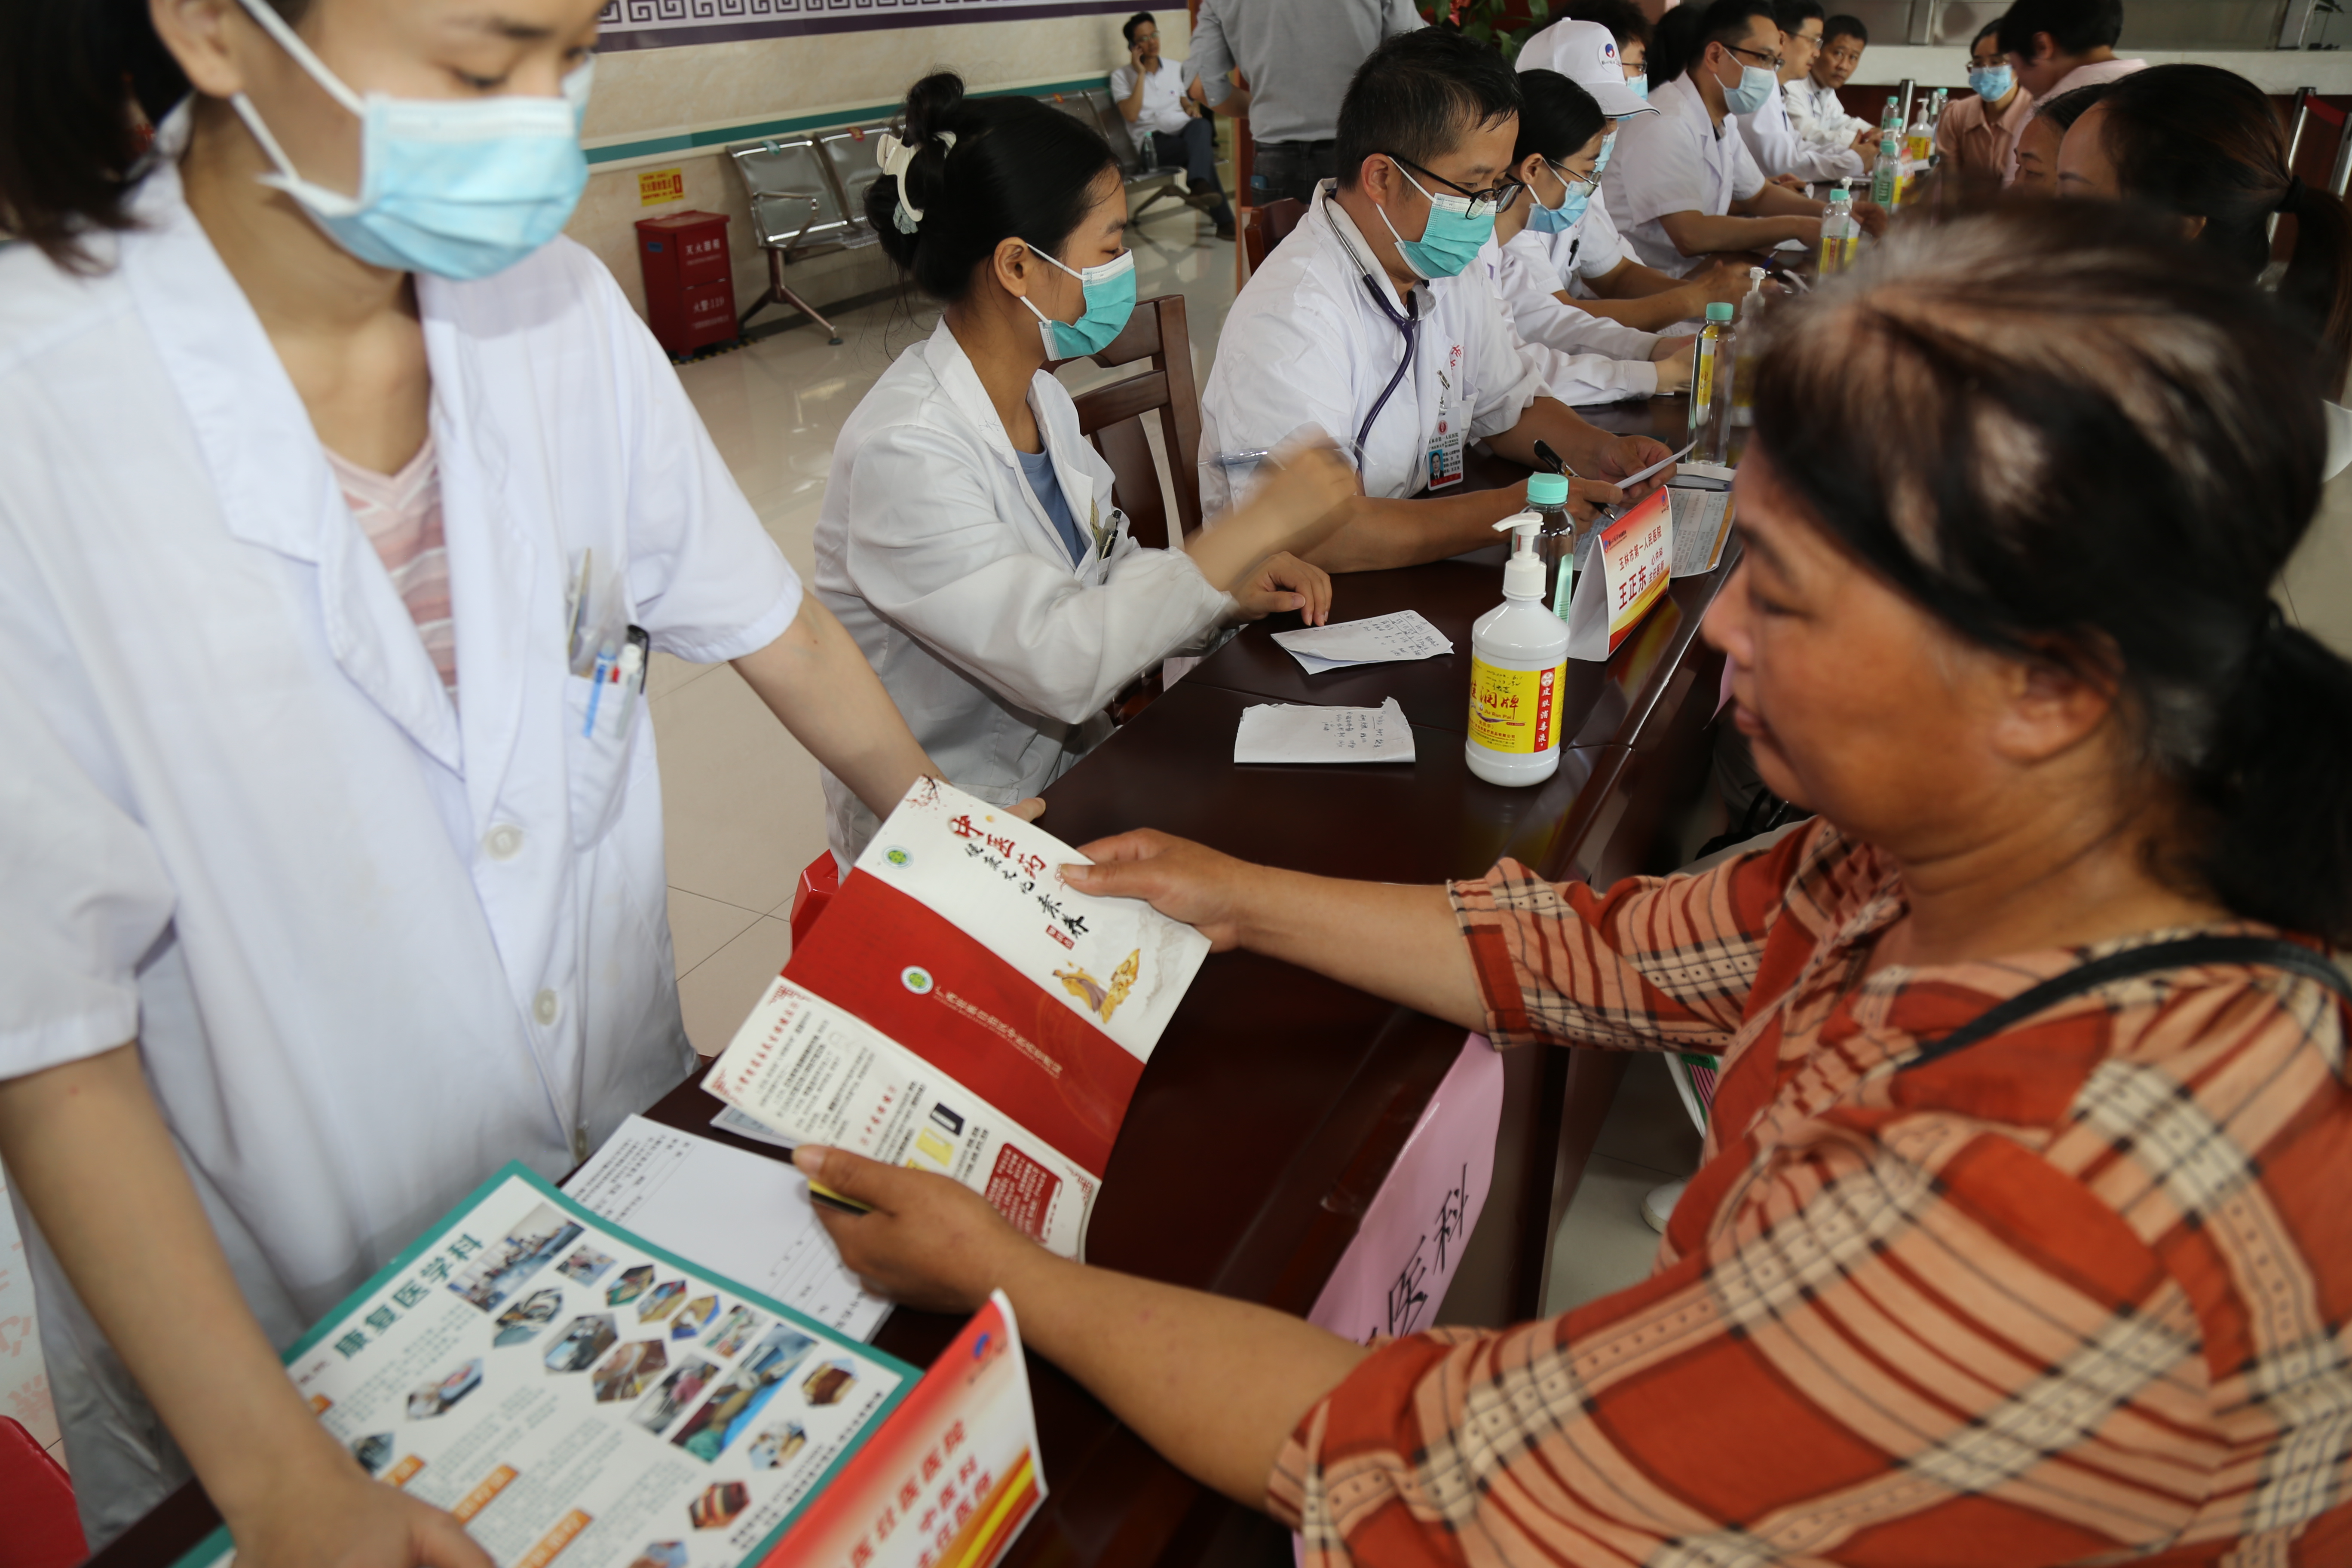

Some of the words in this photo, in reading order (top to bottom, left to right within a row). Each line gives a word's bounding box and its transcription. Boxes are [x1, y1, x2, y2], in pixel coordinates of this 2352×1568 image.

[685, 238, 720, 255] 灭火器箱
[1619, 524, 1662, 571] 玉林市第一人民医院
[1649, 560, 1665, 583] 主任医师
[1651, 546, 1663, 566] 心内科
[1619, 565, 1647, 610] 王正东
[1538, 687, 1551, 742] 皮肤消毒液
[950, 815, 1047, 880] 中医药
[964, 842, 1089, 939] 健康文化素养
[1355, 1162, 1469, 1346] 医科
[333, 1233, 484, 1360] 康复医学科
